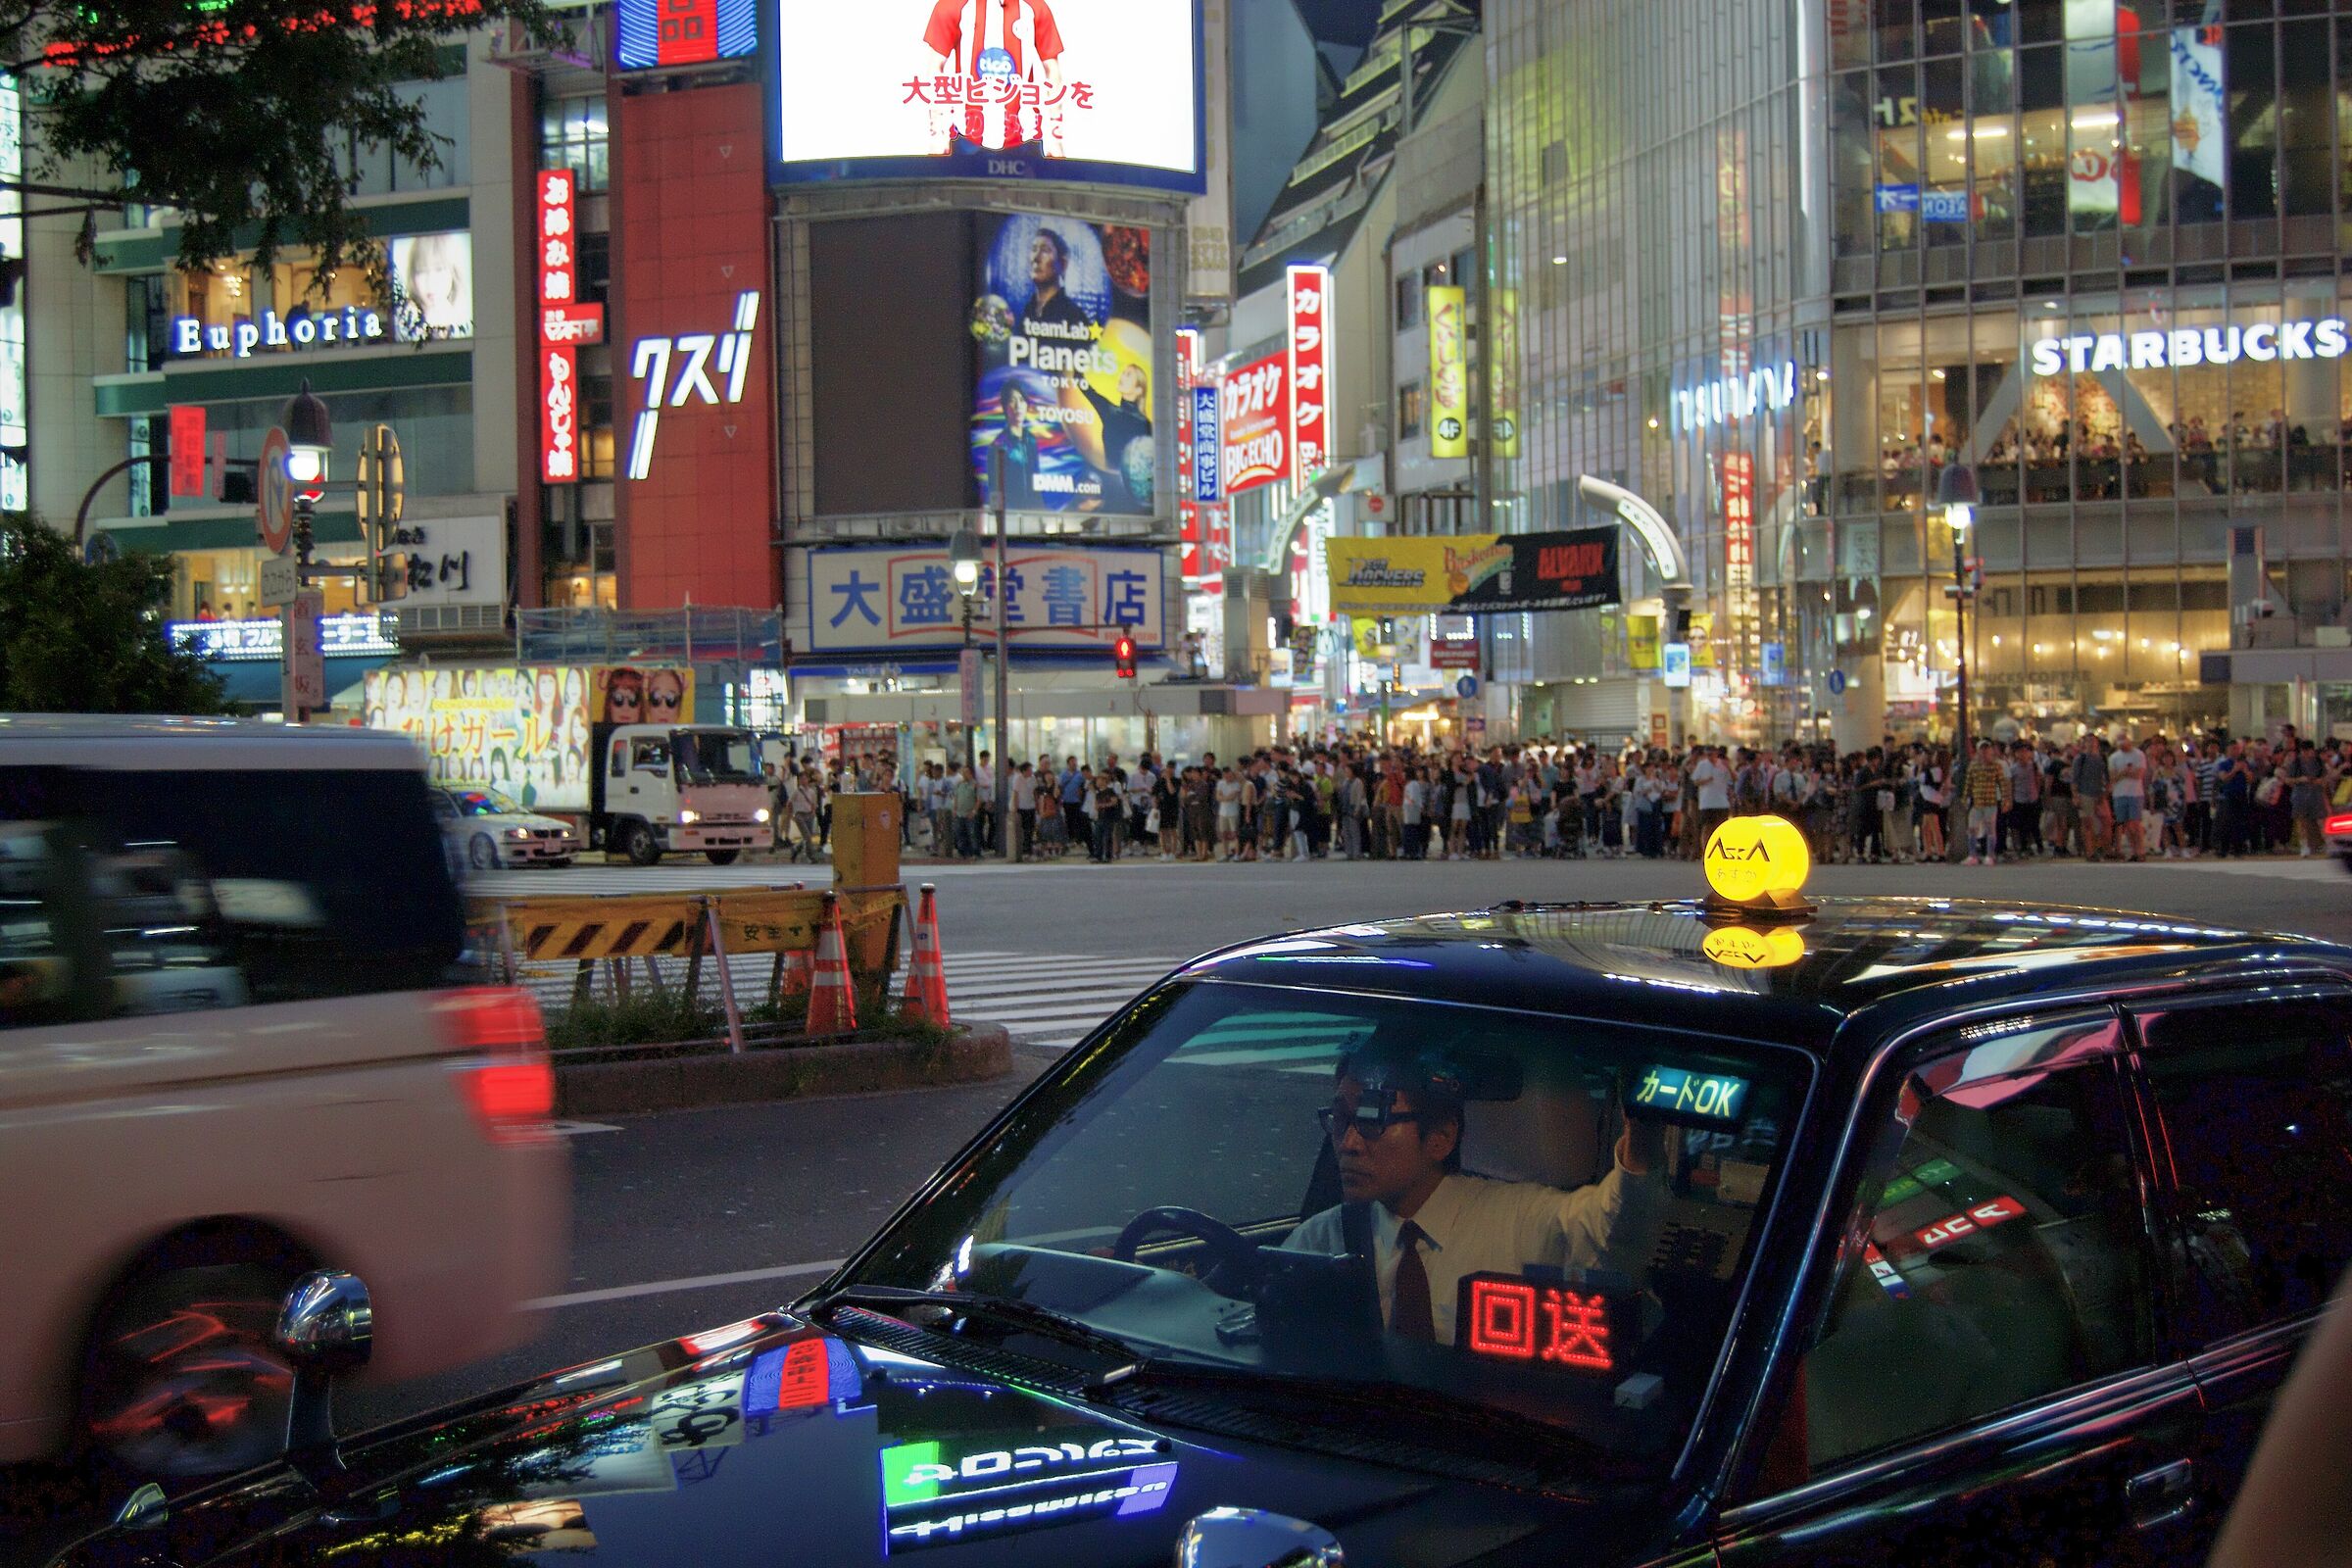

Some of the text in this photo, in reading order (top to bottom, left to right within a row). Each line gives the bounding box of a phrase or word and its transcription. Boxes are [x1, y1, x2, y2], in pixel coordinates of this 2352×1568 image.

[902, 75, 1095, 110] 大型ビジョンを
[987, 159, 1026, 175] DHC
[177, 306, 383, 358] Euphoria
[1023, 317, 1091, 341] teamLab
[2031, 318, 2349, 376] STARBUCKS
[1008, 335, 1117, 374] Planets
[1295, 287, 1323, 426] カラオケ
[628, 290, 760, 480] クスリ
[1041, 374, 1090, 391] TOKYO
[1225, 363, 1283, 422] カラオケ
[1036, 406, 1094, 425] TOYOSU
[1439, 421, 1461, 440] 4F
[263, 568, 293, 598] ここから
[829, 565, 1149, 629] 大盛堂書店
[1635, 1069, 1740, 1118] カードOK
[1471, 1280, 1615, 1370] 回送
